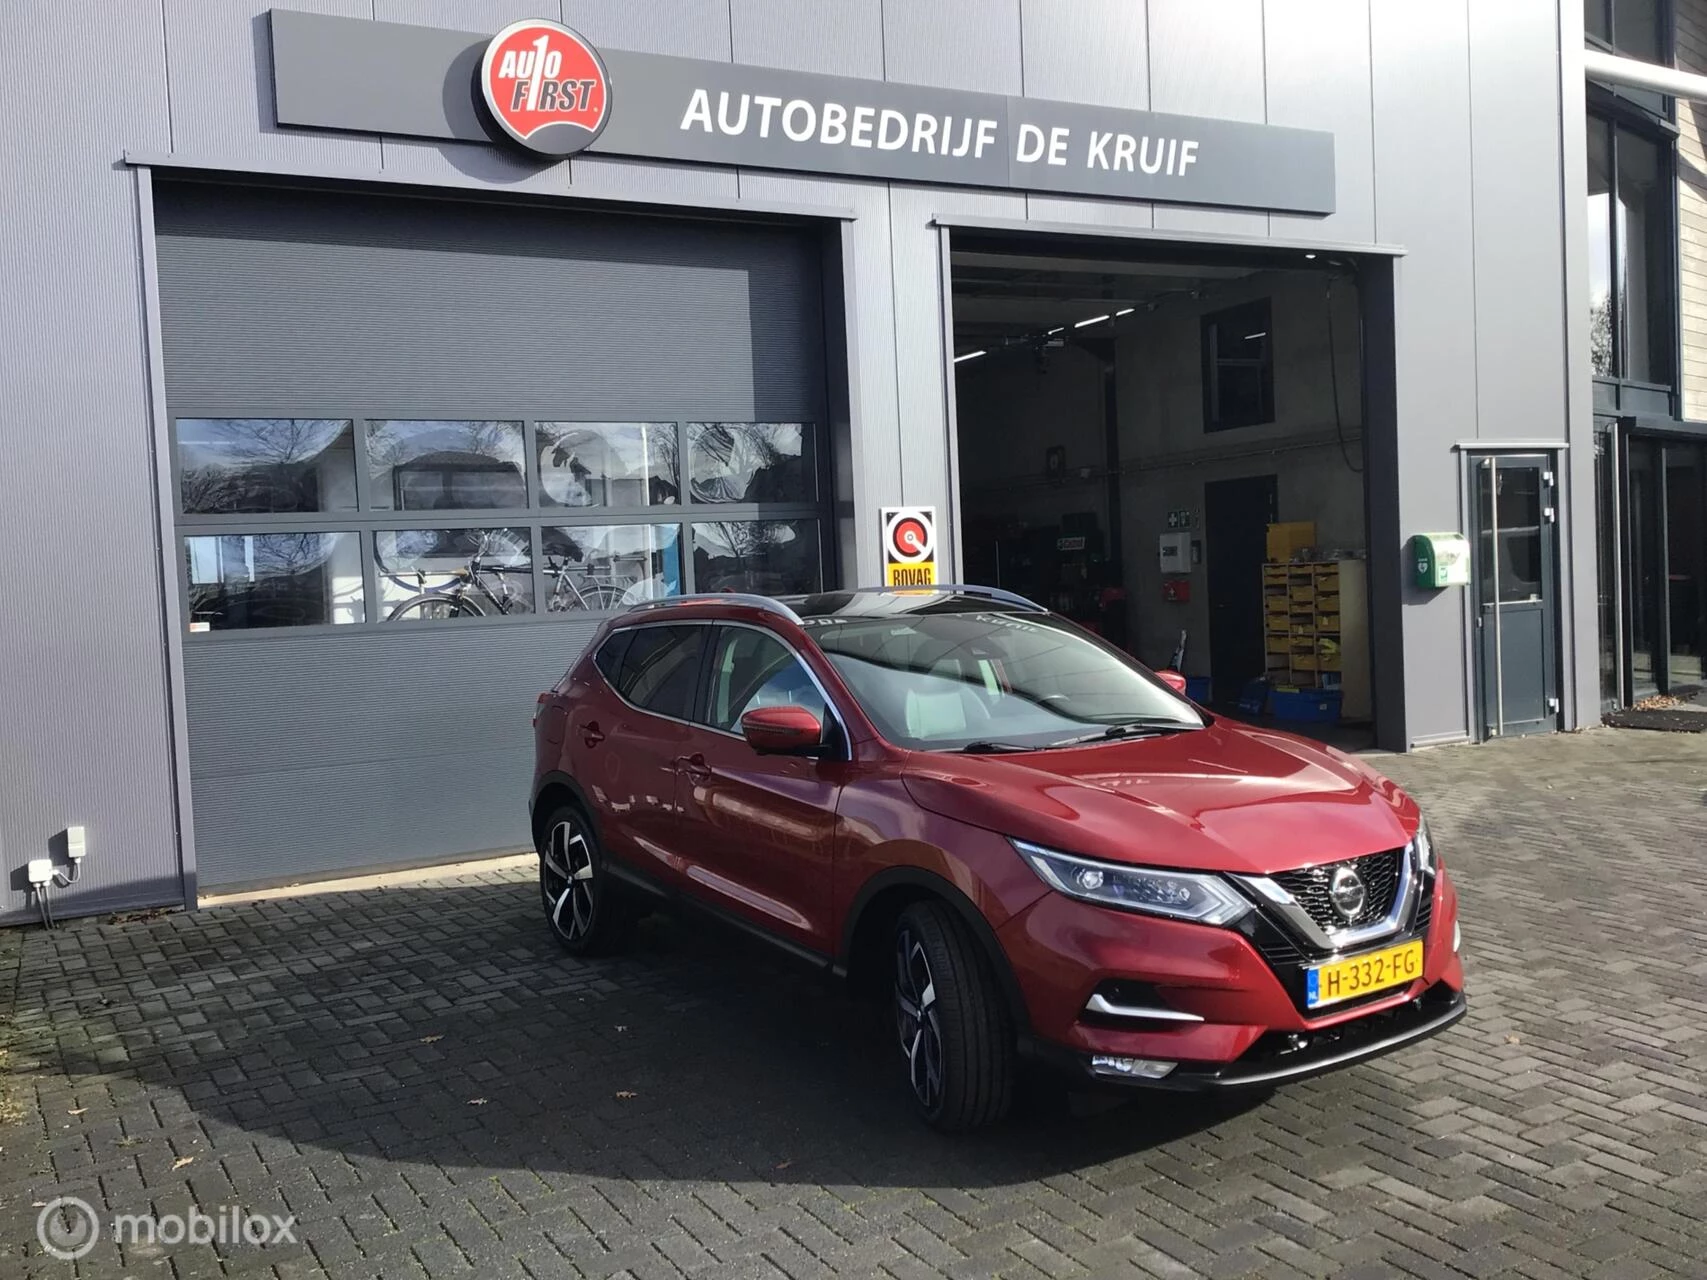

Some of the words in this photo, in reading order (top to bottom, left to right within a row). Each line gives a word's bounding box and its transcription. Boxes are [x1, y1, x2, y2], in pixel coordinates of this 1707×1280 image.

[680, 88, 998, 159] AUTOBEDRIJF
[1016, 123, 1070, 166] DE
[1087, 131, 1199, 177] KRUIF
[1327, 950, 1415, 997] H-332-FG
